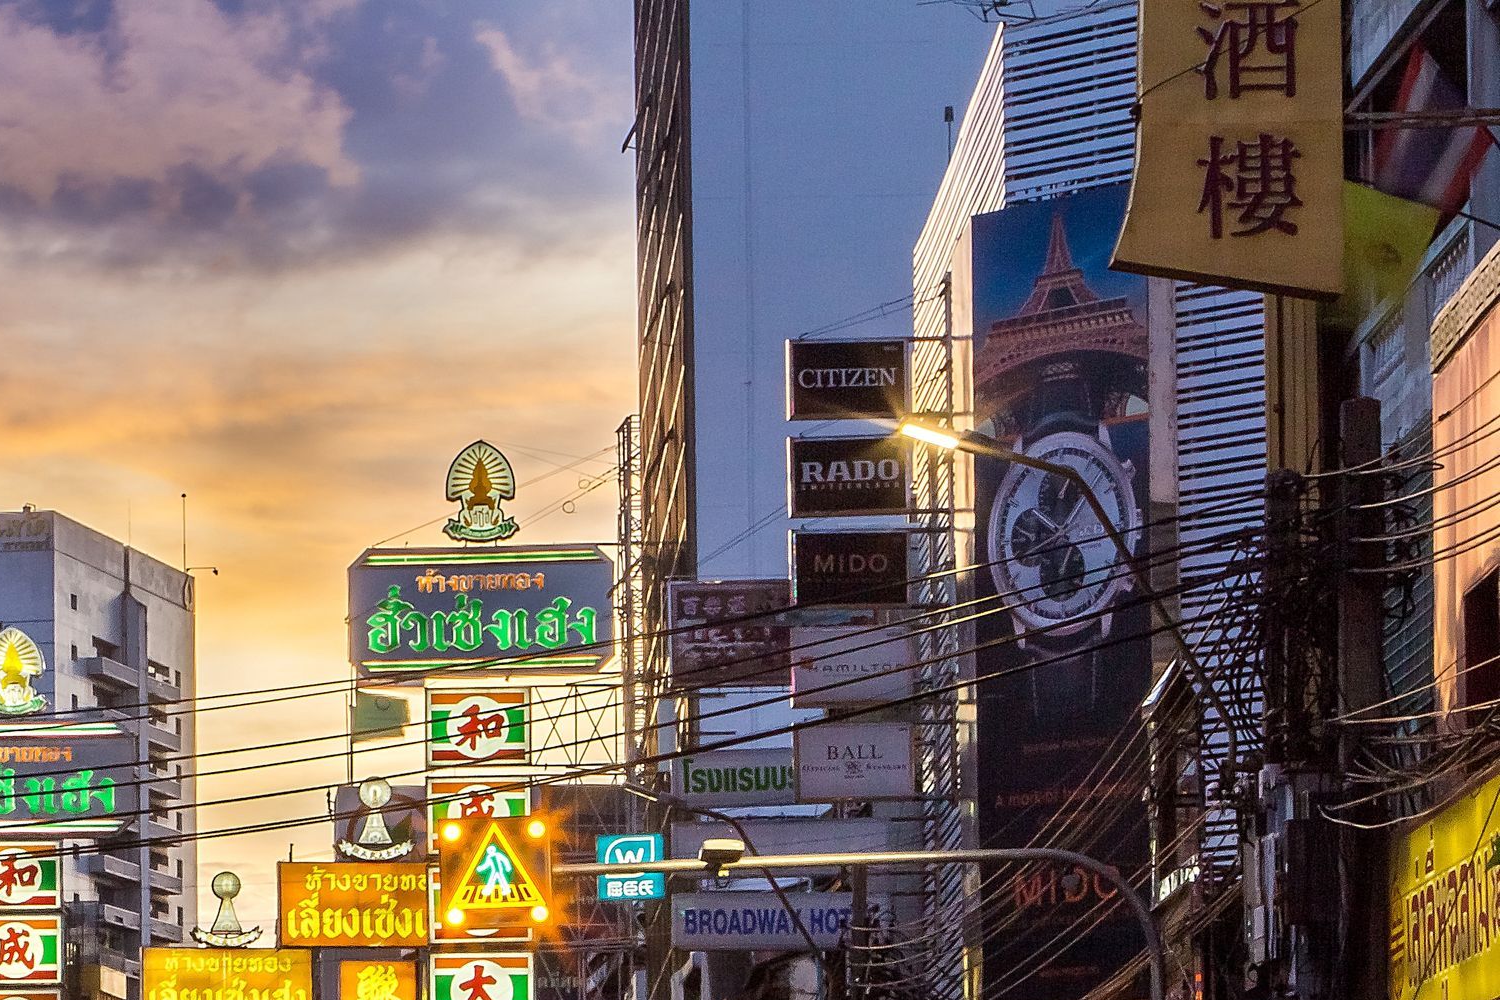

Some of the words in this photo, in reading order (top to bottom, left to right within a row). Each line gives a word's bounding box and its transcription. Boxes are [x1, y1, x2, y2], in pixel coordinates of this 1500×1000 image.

[798, 367, 898, 389] CITIZEN
[801, 459, 900, 483] RADO
[813, 553, 889, 574] MIDO
[415, 568, 545, 593] ห้างขายทอง
[826, 742, 884, 761] BALL
[305, 866, 427, 892] ห้างขายทอ
[606, 880, 655, 897] 屈臣氏
[287, 892, 427, 939] เลี่ยงเซ่งเ
